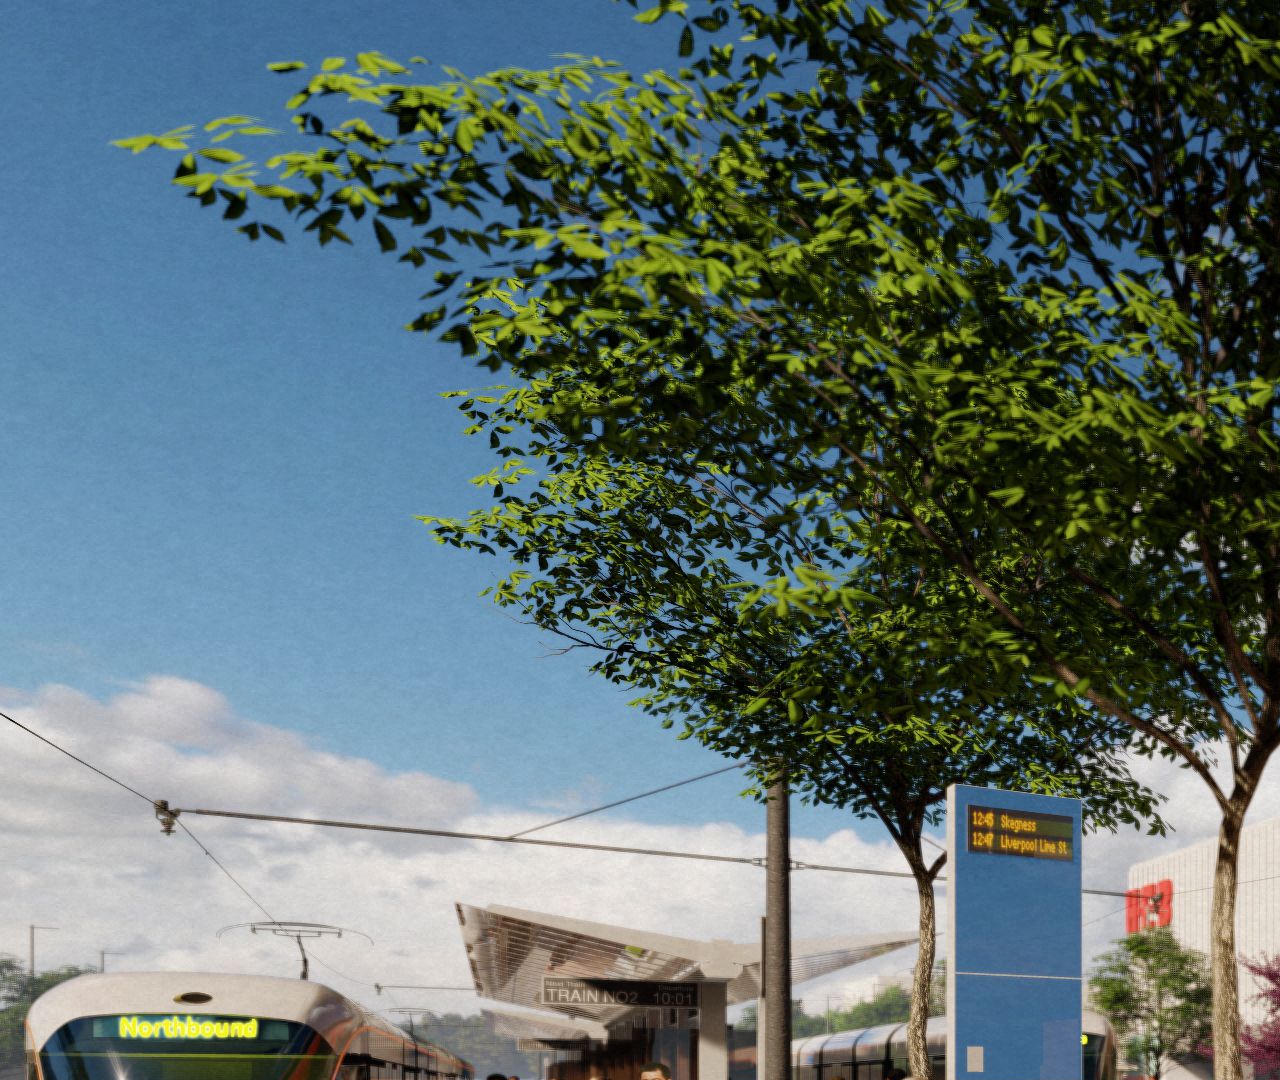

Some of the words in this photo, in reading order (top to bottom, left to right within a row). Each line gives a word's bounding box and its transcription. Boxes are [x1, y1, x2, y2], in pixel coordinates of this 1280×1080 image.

[1001, 836, 1037, 853] Liverpool
[546, 988, 597, 1003] TRAIN
[653, 992, 692, 1005] 10:01
[118, 1016, 259, 1039] Northbound
